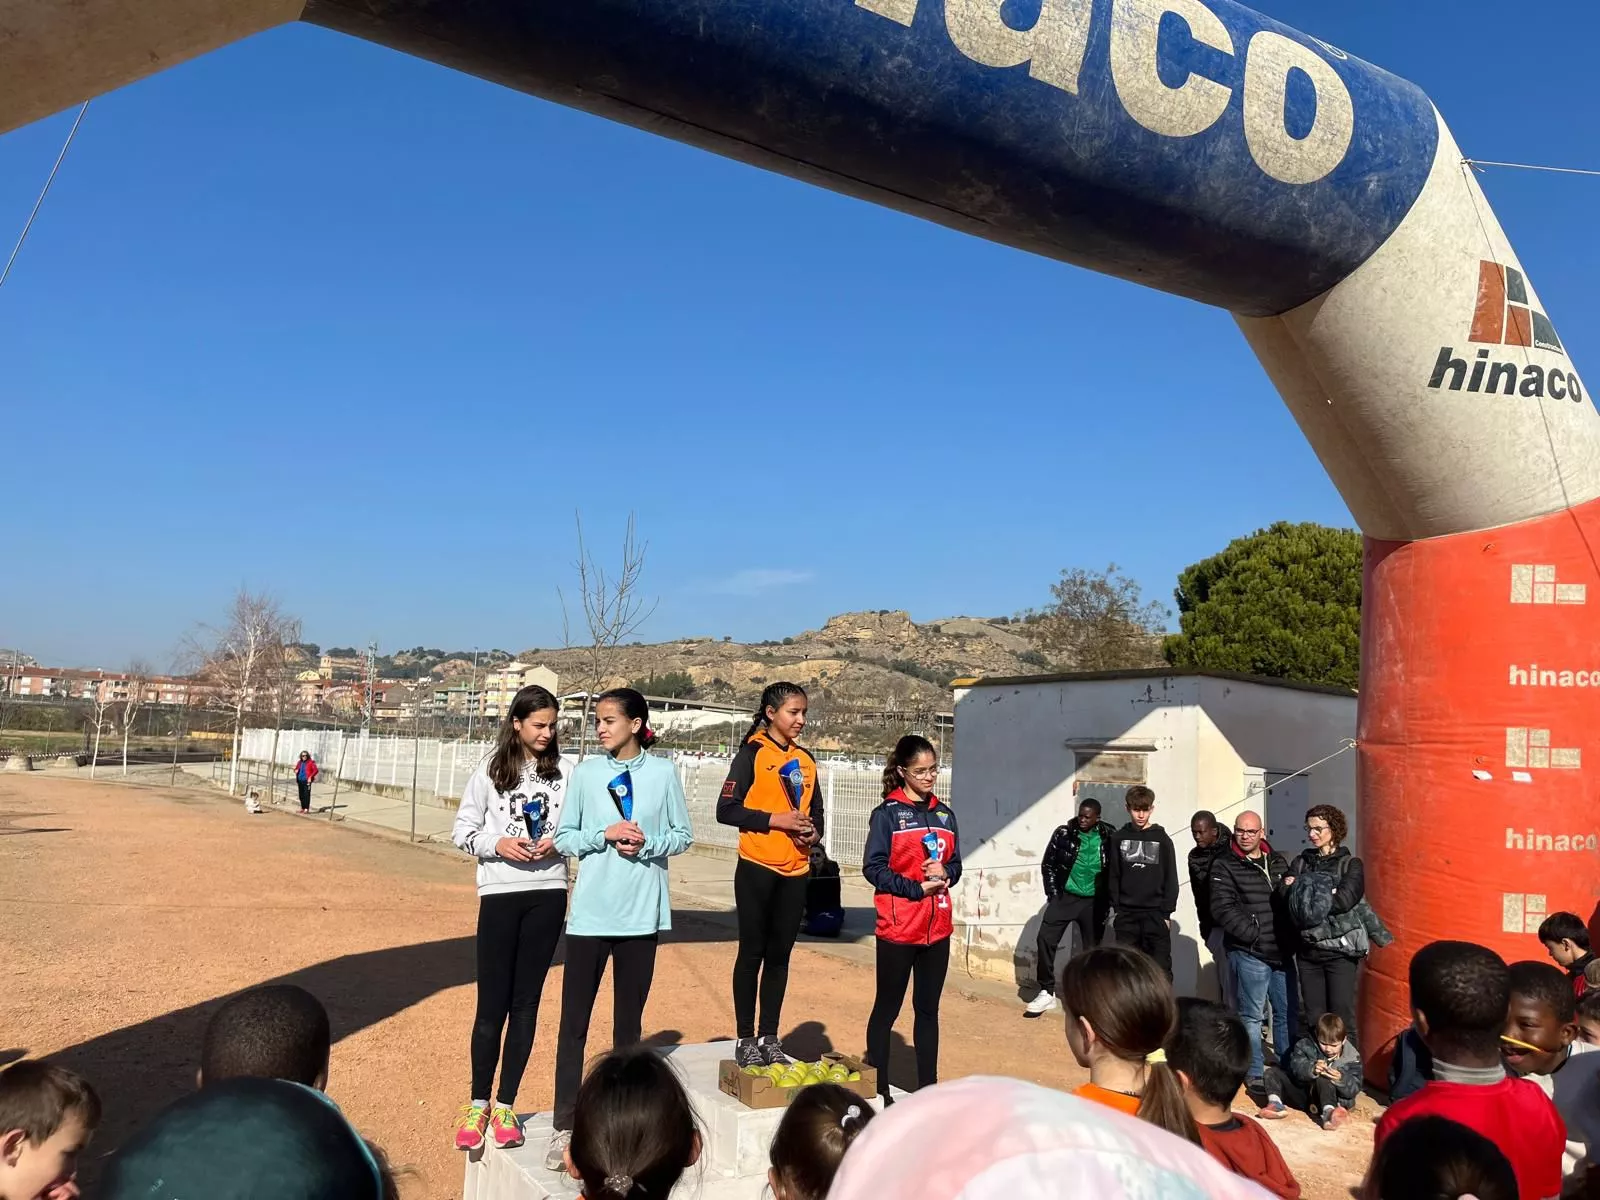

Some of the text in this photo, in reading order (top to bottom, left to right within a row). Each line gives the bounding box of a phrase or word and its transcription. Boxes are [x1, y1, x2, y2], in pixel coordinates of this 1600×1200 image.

[1428, 347, 1582, 403] hinaco
[1509, 663, 1600, 687] hinaco
[505, 822, 524, 838] EST
[1505, 827, 1597, 852] hinaco
